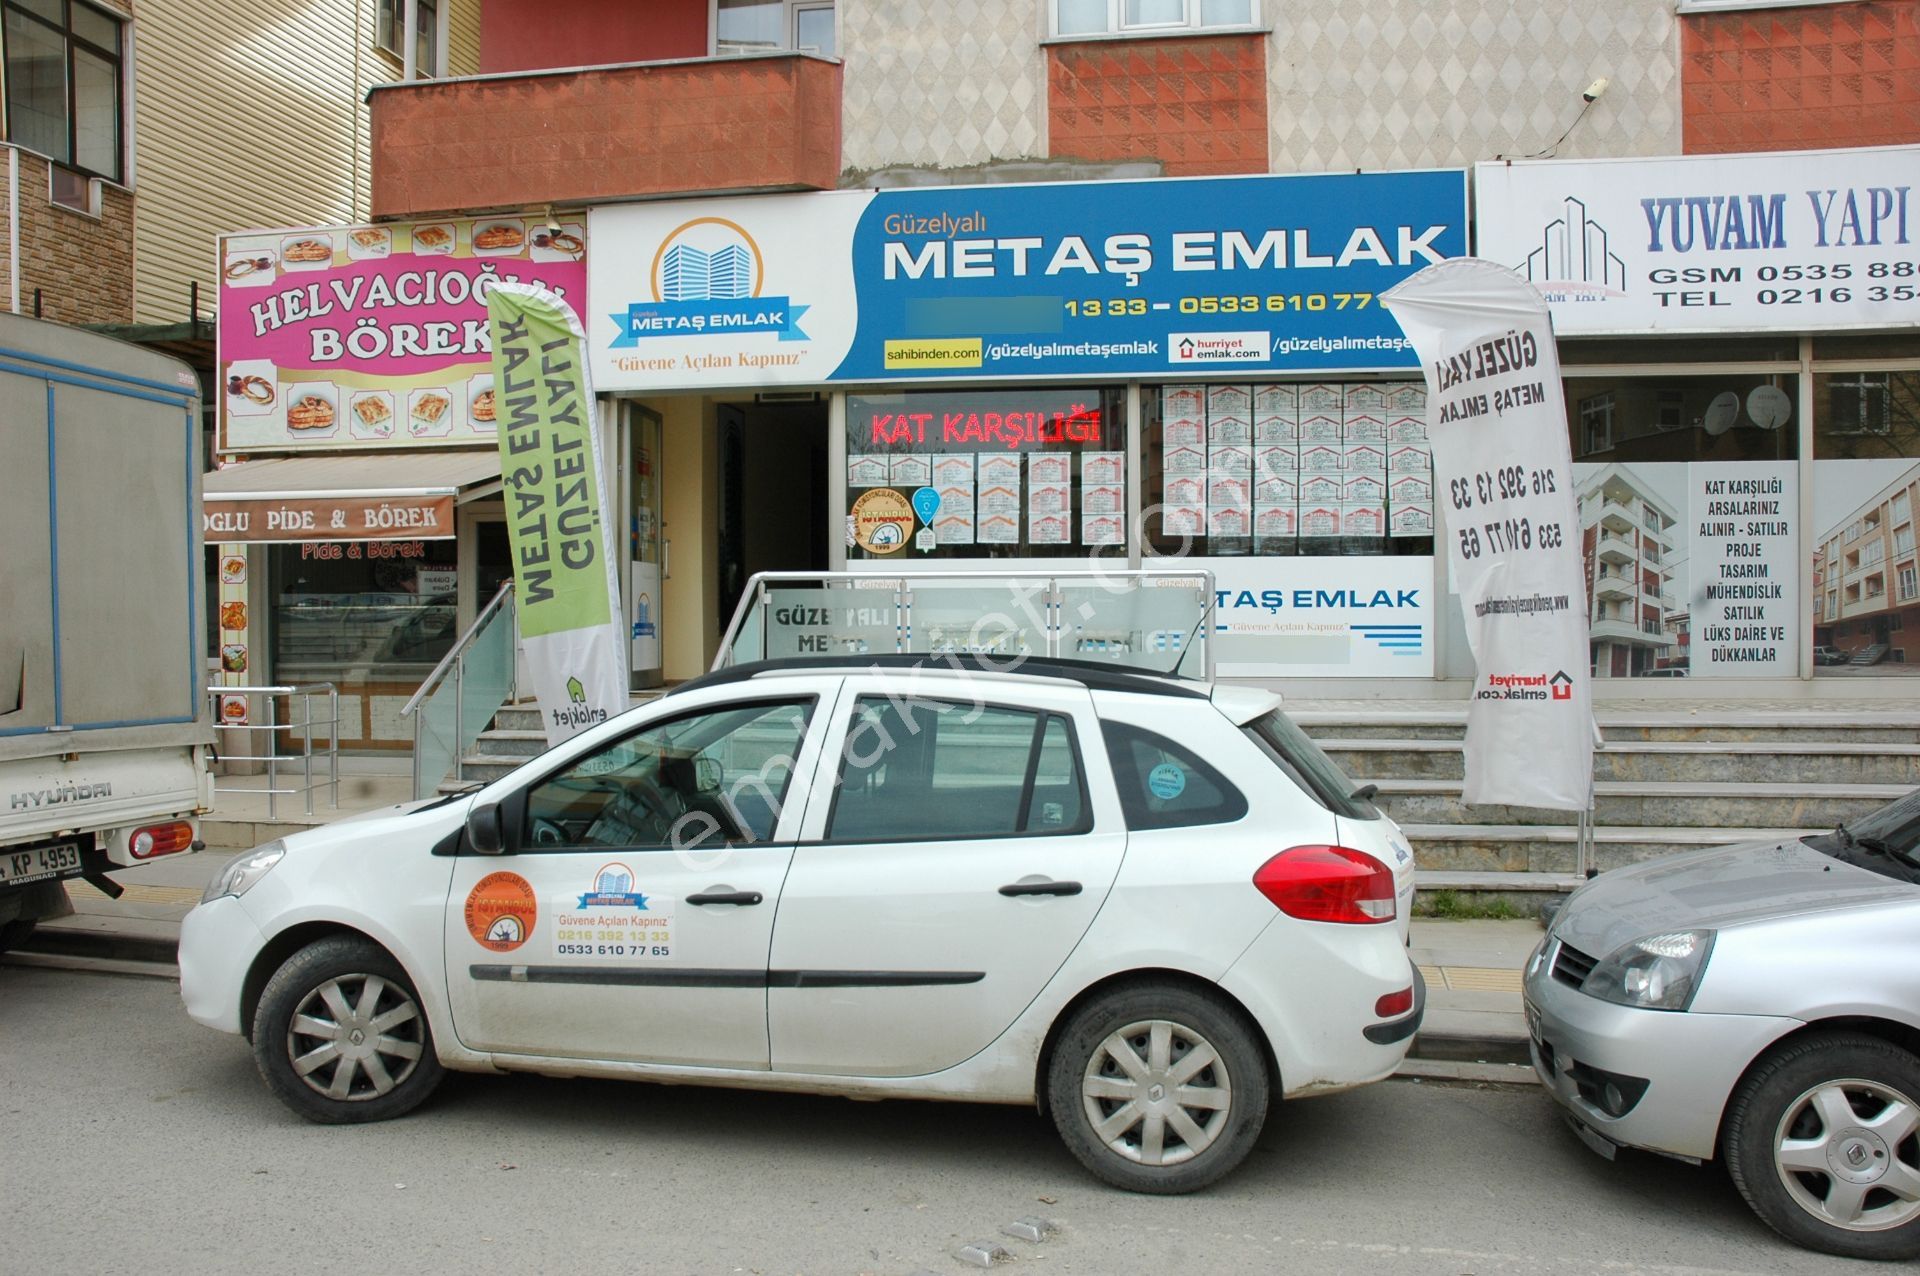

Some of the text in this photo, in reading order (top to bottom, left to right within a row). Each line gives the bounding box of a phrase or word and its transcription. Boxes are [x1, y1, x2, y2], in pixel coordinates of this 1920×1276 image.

[884, 211, 986, 238] Güzelyalı
[1640, 186, 1911, 253] YUVAM YAPI
[884, 225, 1447, 287] METAŞ EMLAK
[1648, 261, 1920, 284] GSM 0535 88
[1064, 300, 1101, 317] 13
[1108, 299, 1147, 316] 33
[1179, 296, 1260, 314] 0533
[1266, 294, 1327, 312] 610
[1333, 293, 1373, 310] 77
[1652, 285, 1920, 307] TEL 0216 35
[632, 312, 784, 331] METAŞ EMLAK
[887, 347, 980, 361] sahibinden.com
[984, 341, 1159, 362] /güzelyalımetaşemlak
[1197, 349, 1260, 359] emlak.com
[1197, 339, 1243, 350] hurriyet
[683, 352, 732, 373] Açılan
[872, 403, 1102, 448] KAT KARŞILIĞI
[1705, 476, 1782, 498] KAT KARŞILIĞI
[267, 506, 316, 530] PİDE
[330, 509, 346, 528] &
[364, 504, 438, 529] BÖREK
[1708, 501, 1779, 515] ARSALARINIZ
[1699, 522, 1735, 537] ALINIR
[1747, 521, 1788, 536] SATILIR
[302, 542, 343, 560] Pide
[347, 542, 361, 559] &
[1726, 543, 1762, 557] PROJE
[1720, 564, 1768, 578] TASARIM
[1293, 590, 1420, 608] EMLAK
[1706, 582, 1782, 600] MÜHENDİSLİK
[1724, 606, 1764, 620] SATILIK
[1704, 624, 1784, 641] LÜKS DAİRE VE
[1712, 645, 1776, 662] DÜKKANLAR
[11, 782, 112, 809] HYUNDAI
[11, 853, 31, 876] KP
[40, 846, 77, 869] 4953
[598, 914, 628, 928] Açılan
[558, 930, 670, 941] 0216 392 13 33
[558, 944, 670, 956] 0533 610 77 65
